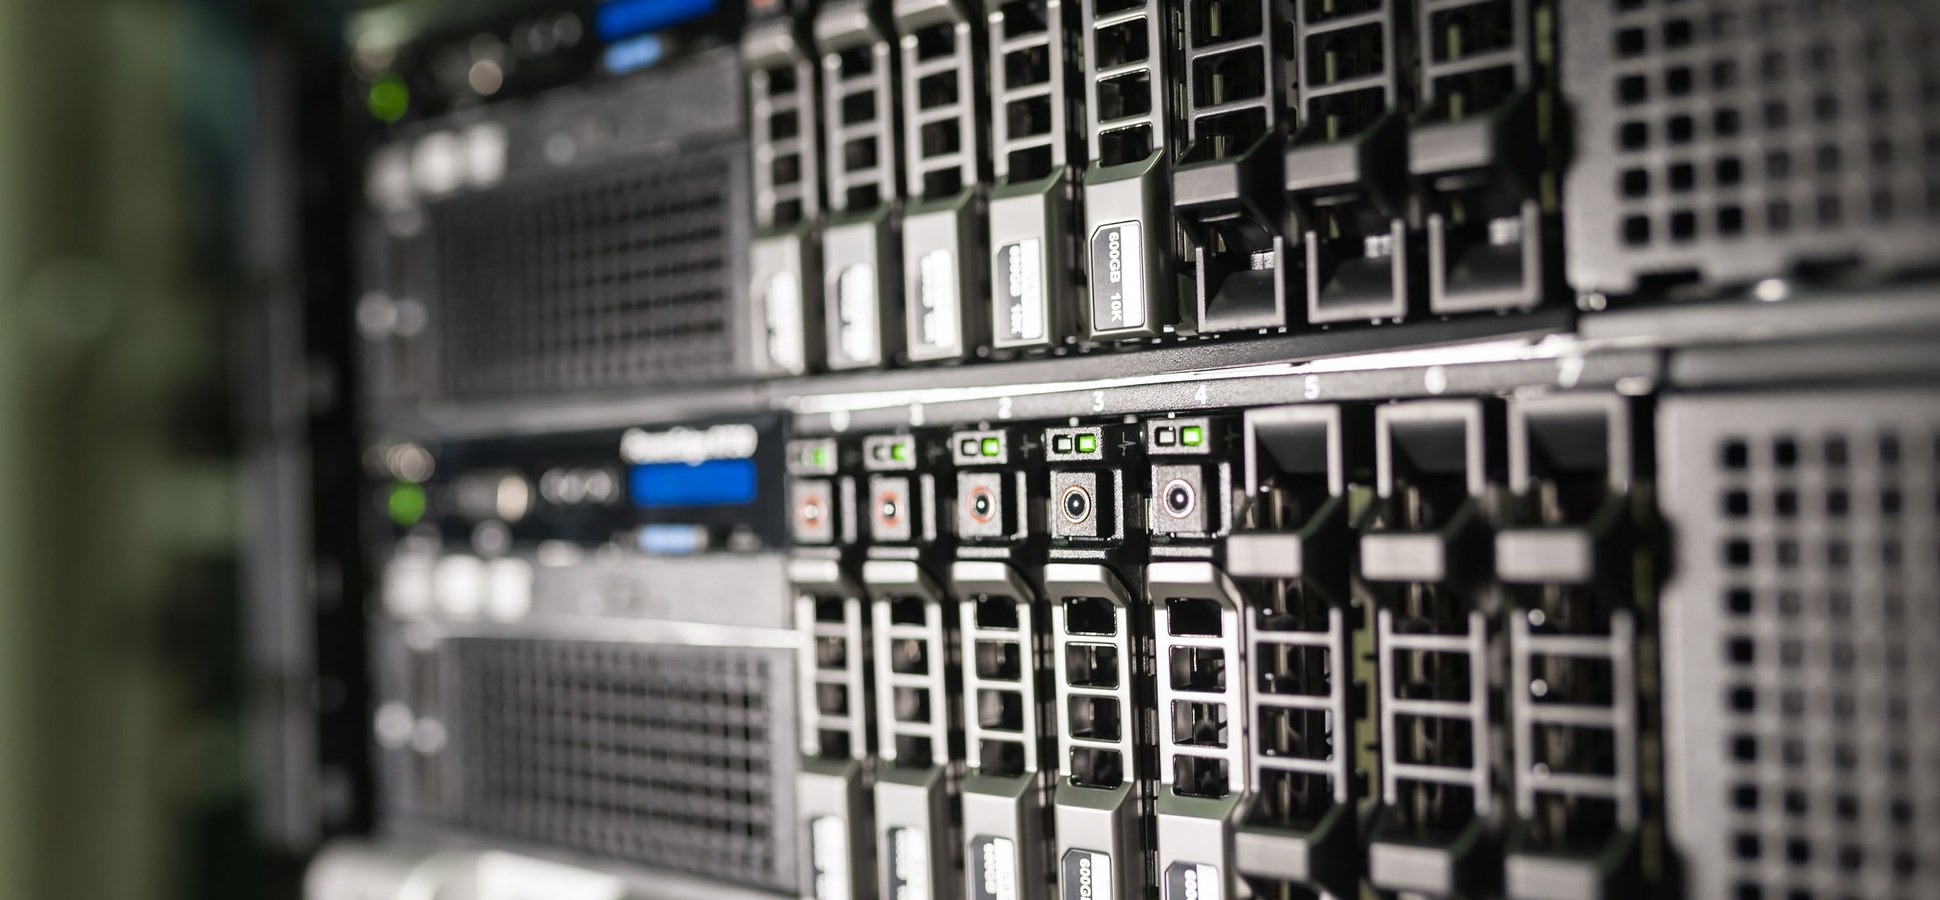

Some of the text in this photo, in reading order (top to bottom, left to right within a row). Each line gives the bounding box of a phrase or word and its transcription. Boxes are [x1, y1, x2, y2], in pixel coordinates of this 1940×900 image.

[1109, 231, 1123, 323] 600GB 10K
[1194, 384, 1208, 405] 4
[1304, 374, 1321, 400] 5
[1092, 390, 1105, 412] 3
[1079, 858, 1092, 900] 600G
